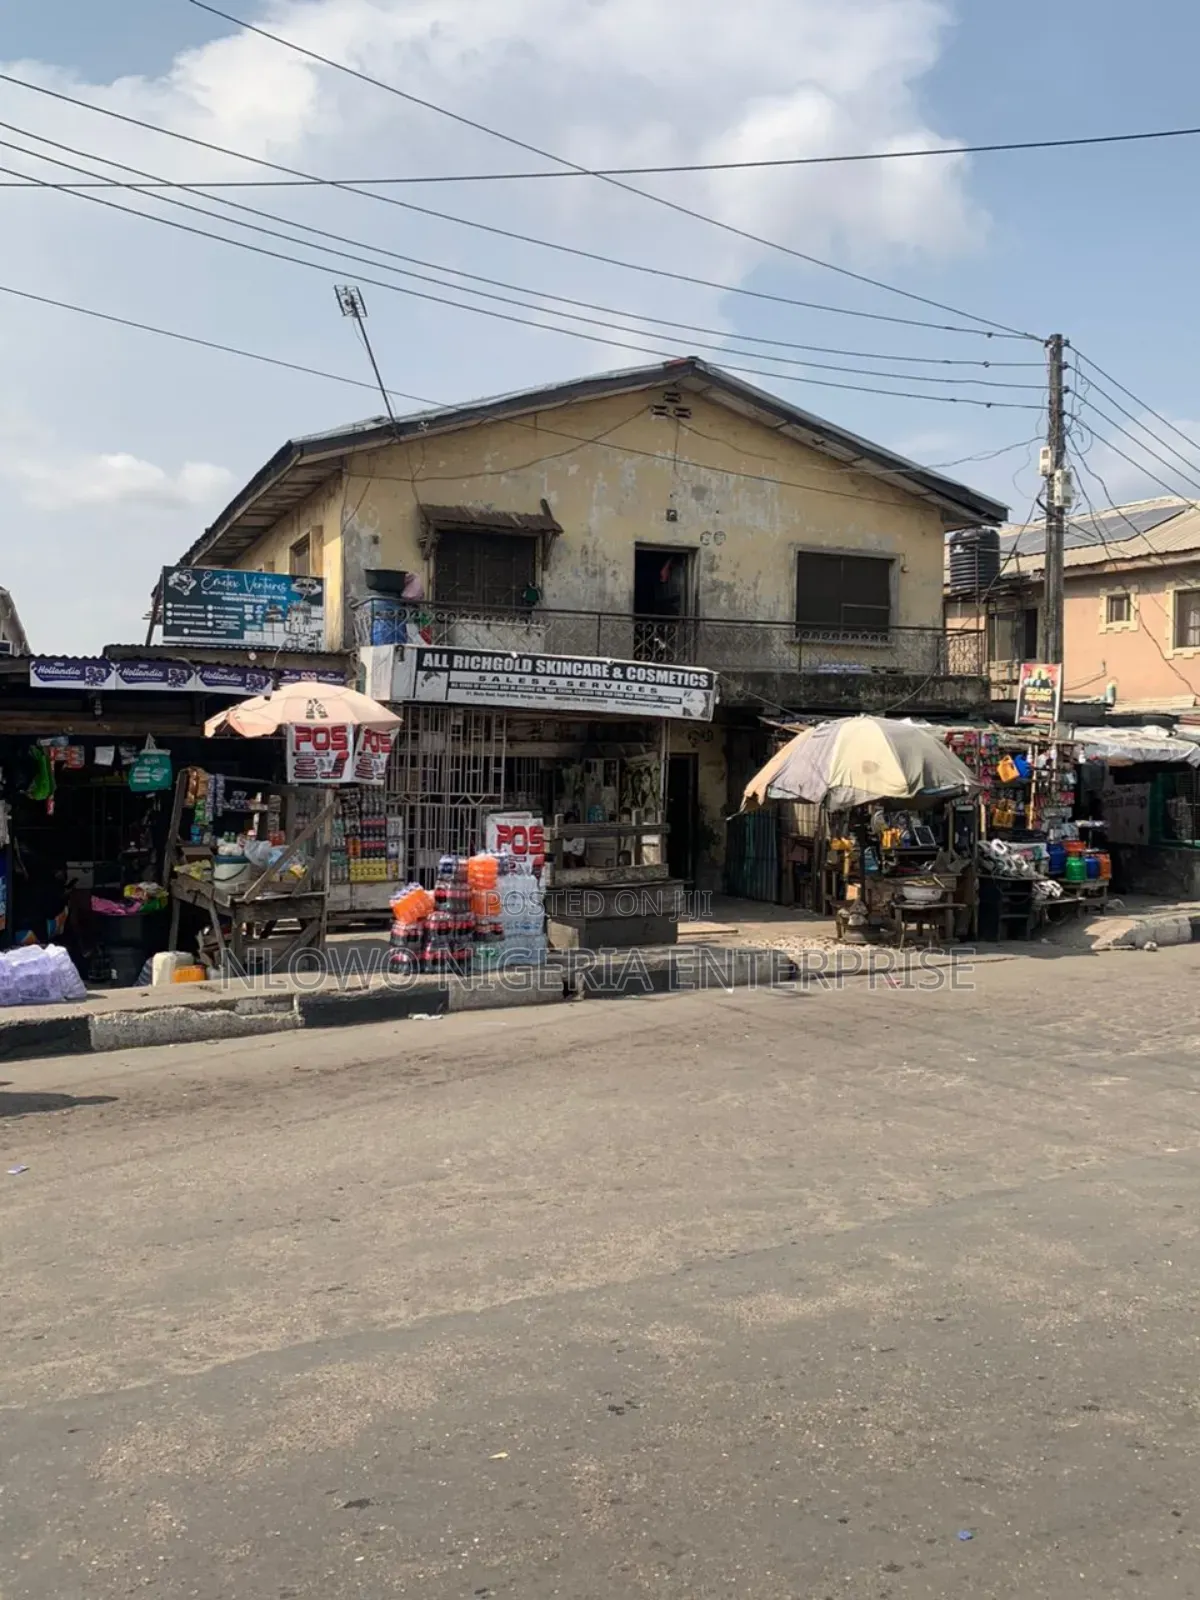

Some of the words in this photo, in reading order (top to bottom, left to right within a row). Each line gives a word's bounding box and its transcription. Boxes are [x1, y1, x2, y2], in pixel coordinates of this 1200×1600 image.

[243, 573, 288, 594] Ventures
[37, 665, 81, 676] Hollandia
[121, 668, 164, 678] Hollandia
[202, 671, 243, 682] Hollandia
[422, 652, 449, 668] ALL
[453, 656, 532, 673] RICHGOLD
[536, 659, 610, 678] SKINCARE
[613, 666, 623, 679] &
[626, 668, 709, 688] COSMETICS
[478, 675, 540, 685] SALES
[566, 680, 658, 694] SERVICES
[294, 725, 348, 751] POS
[362, 729, 392, 753] POS
[496, 824, 544, 855] POS
